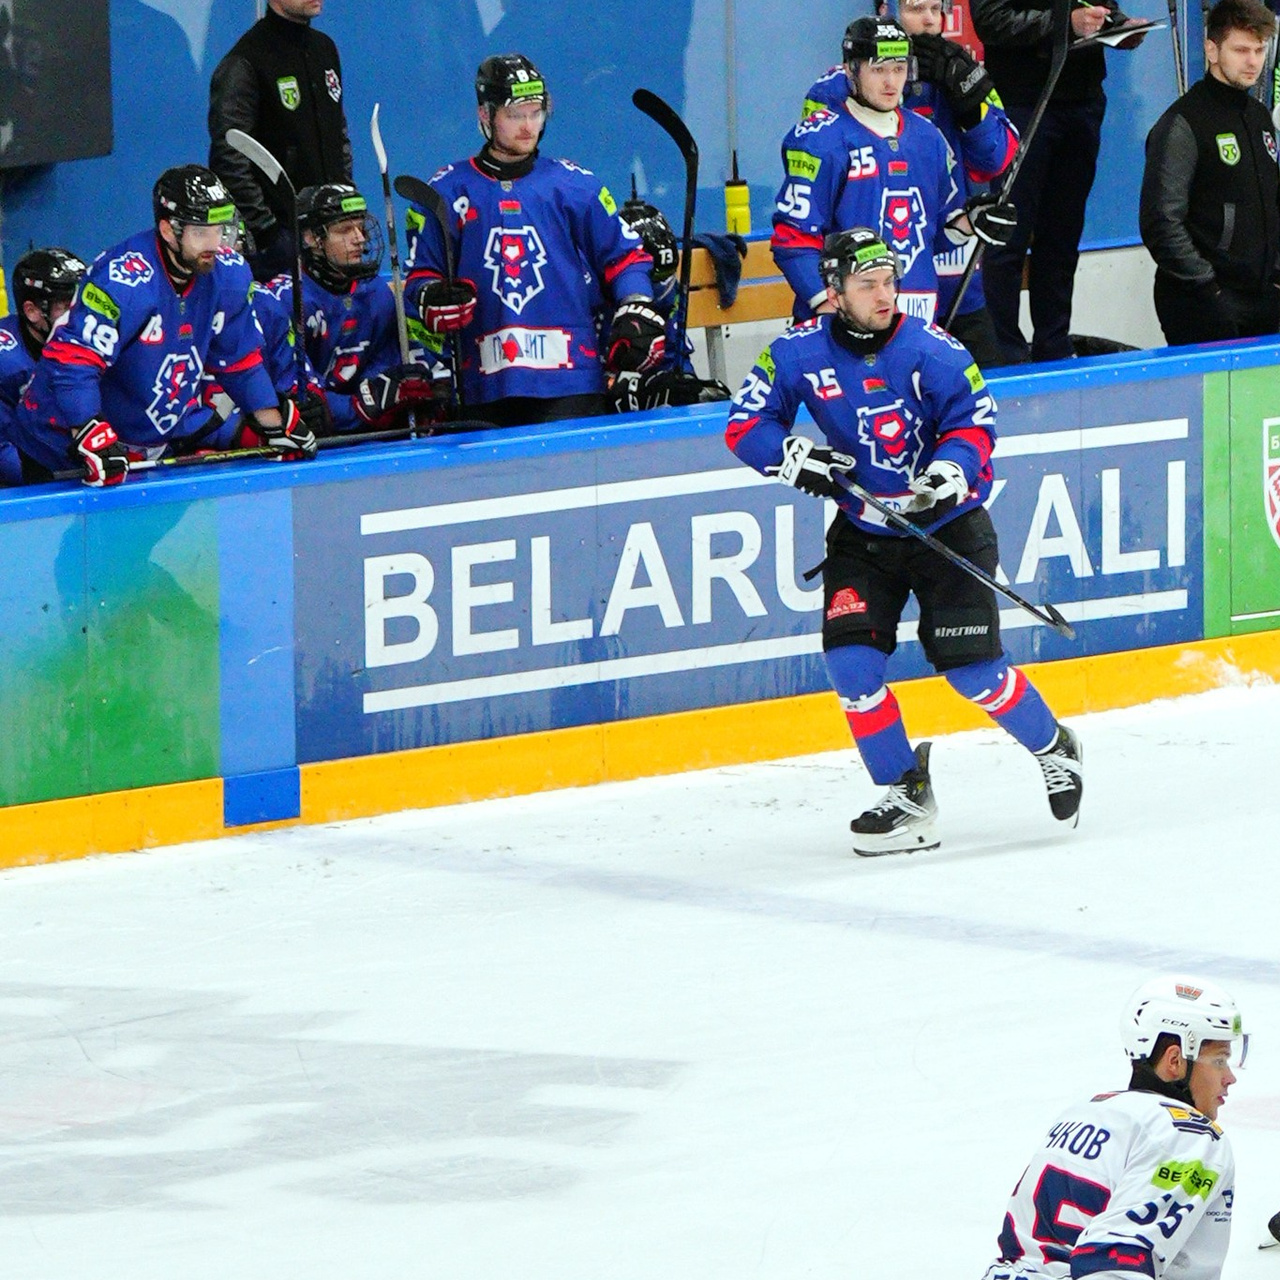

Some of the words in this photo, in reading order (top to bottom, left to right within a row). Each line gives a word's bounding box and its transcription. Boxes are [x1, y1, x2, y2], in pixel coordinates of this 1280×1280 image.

[849, 145, 877, 178] 55
[658, 248, 673, 265] 13
[82, 314, 119, 356] 18
[733, 372, 772, 412] 25
[363, 460, 1187, 668] BELARUALI
[1161, 1018, 1190, 1028] CCM
[1045, 1121, 1111, 1160] ЧКОВ
